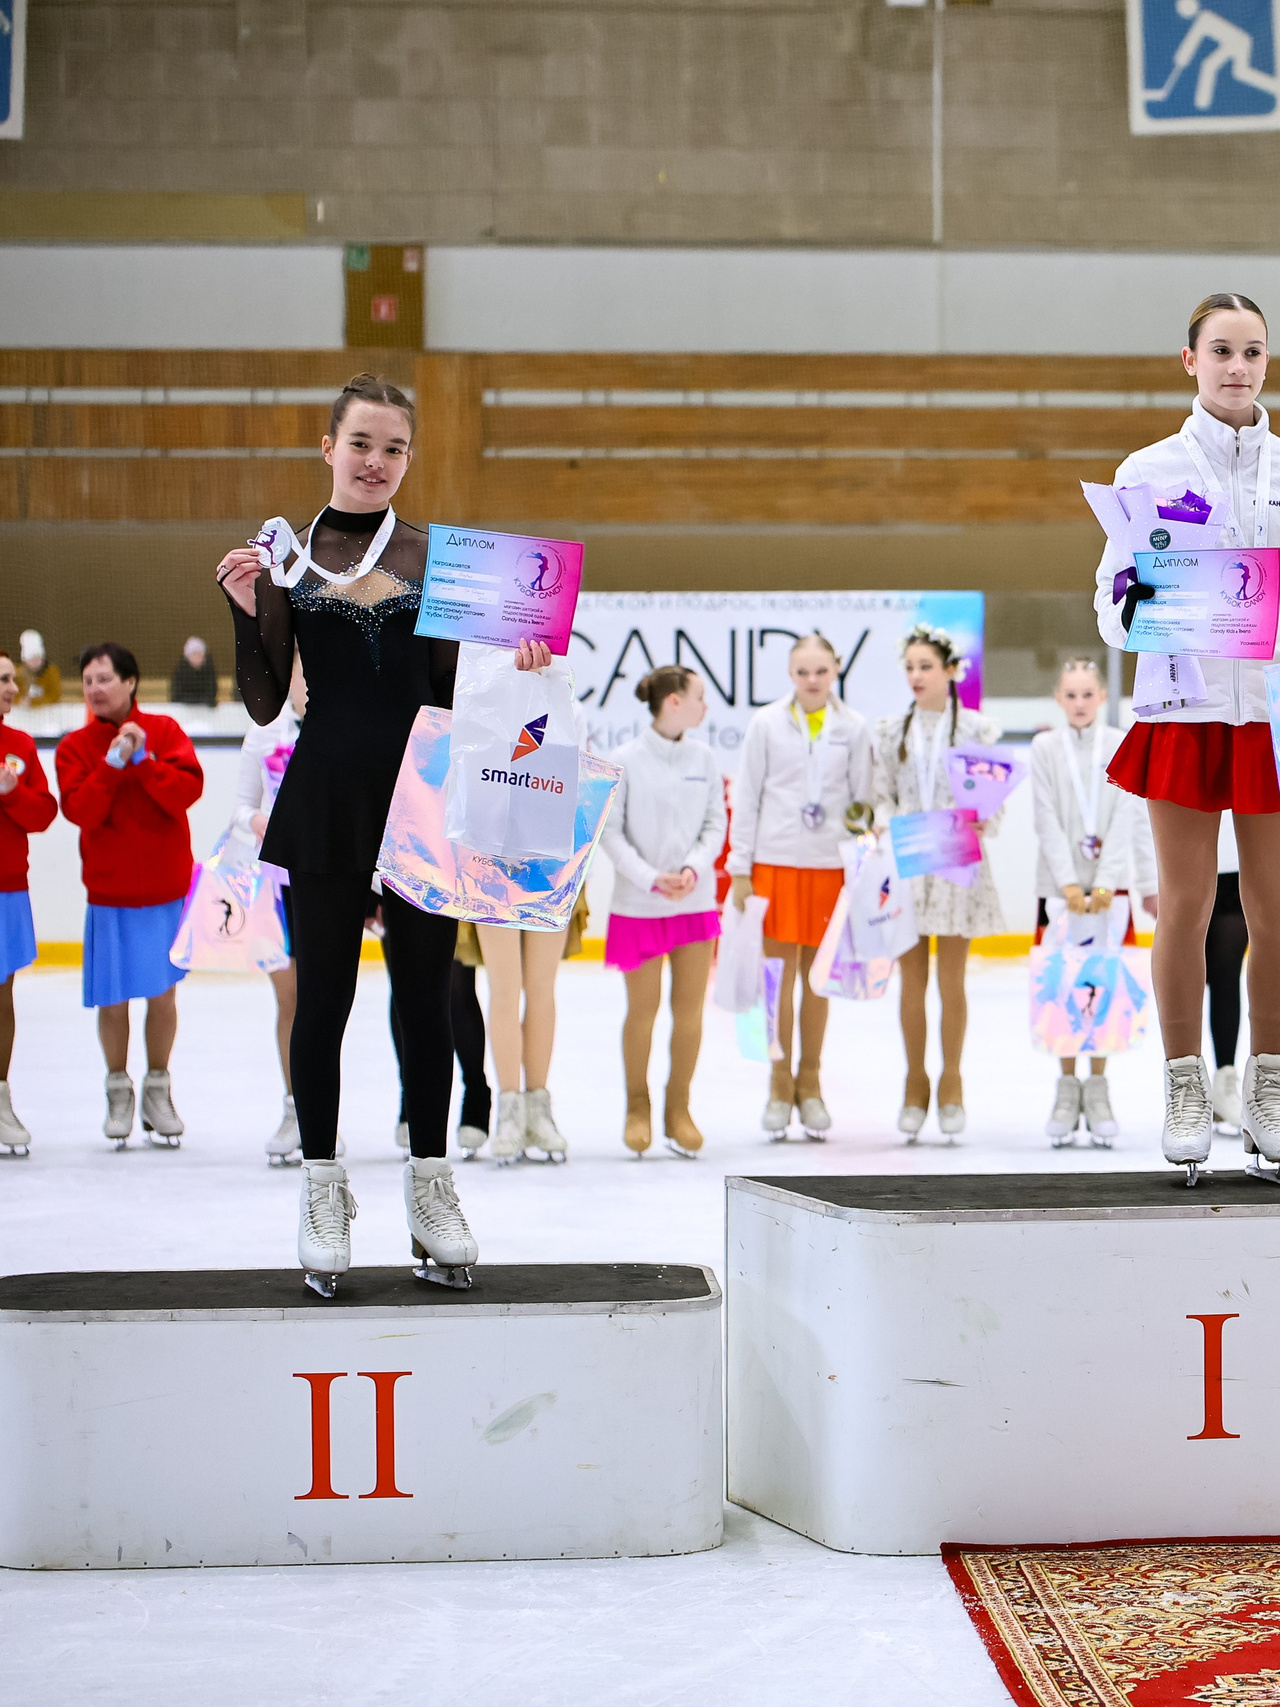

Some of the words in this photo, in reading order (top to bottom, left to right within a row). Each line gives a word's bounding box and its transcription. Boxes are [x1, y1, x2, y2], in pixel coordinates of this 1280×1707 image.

[432, 560, 471, 569] Награждается
[514, 577, 537, 599] КУБОК
[538, 583, 564, 600] CANDY
[1220, 590, 1242, 608] КУБОК
[1243, 590, 1266, 608] CANDY
[570, 628, 870, 708] ANDY
[481, 767, 564, 795] smartavia
[472, 855, 497, 868] КУБОК
[294, 1372, 412, 1499] II
